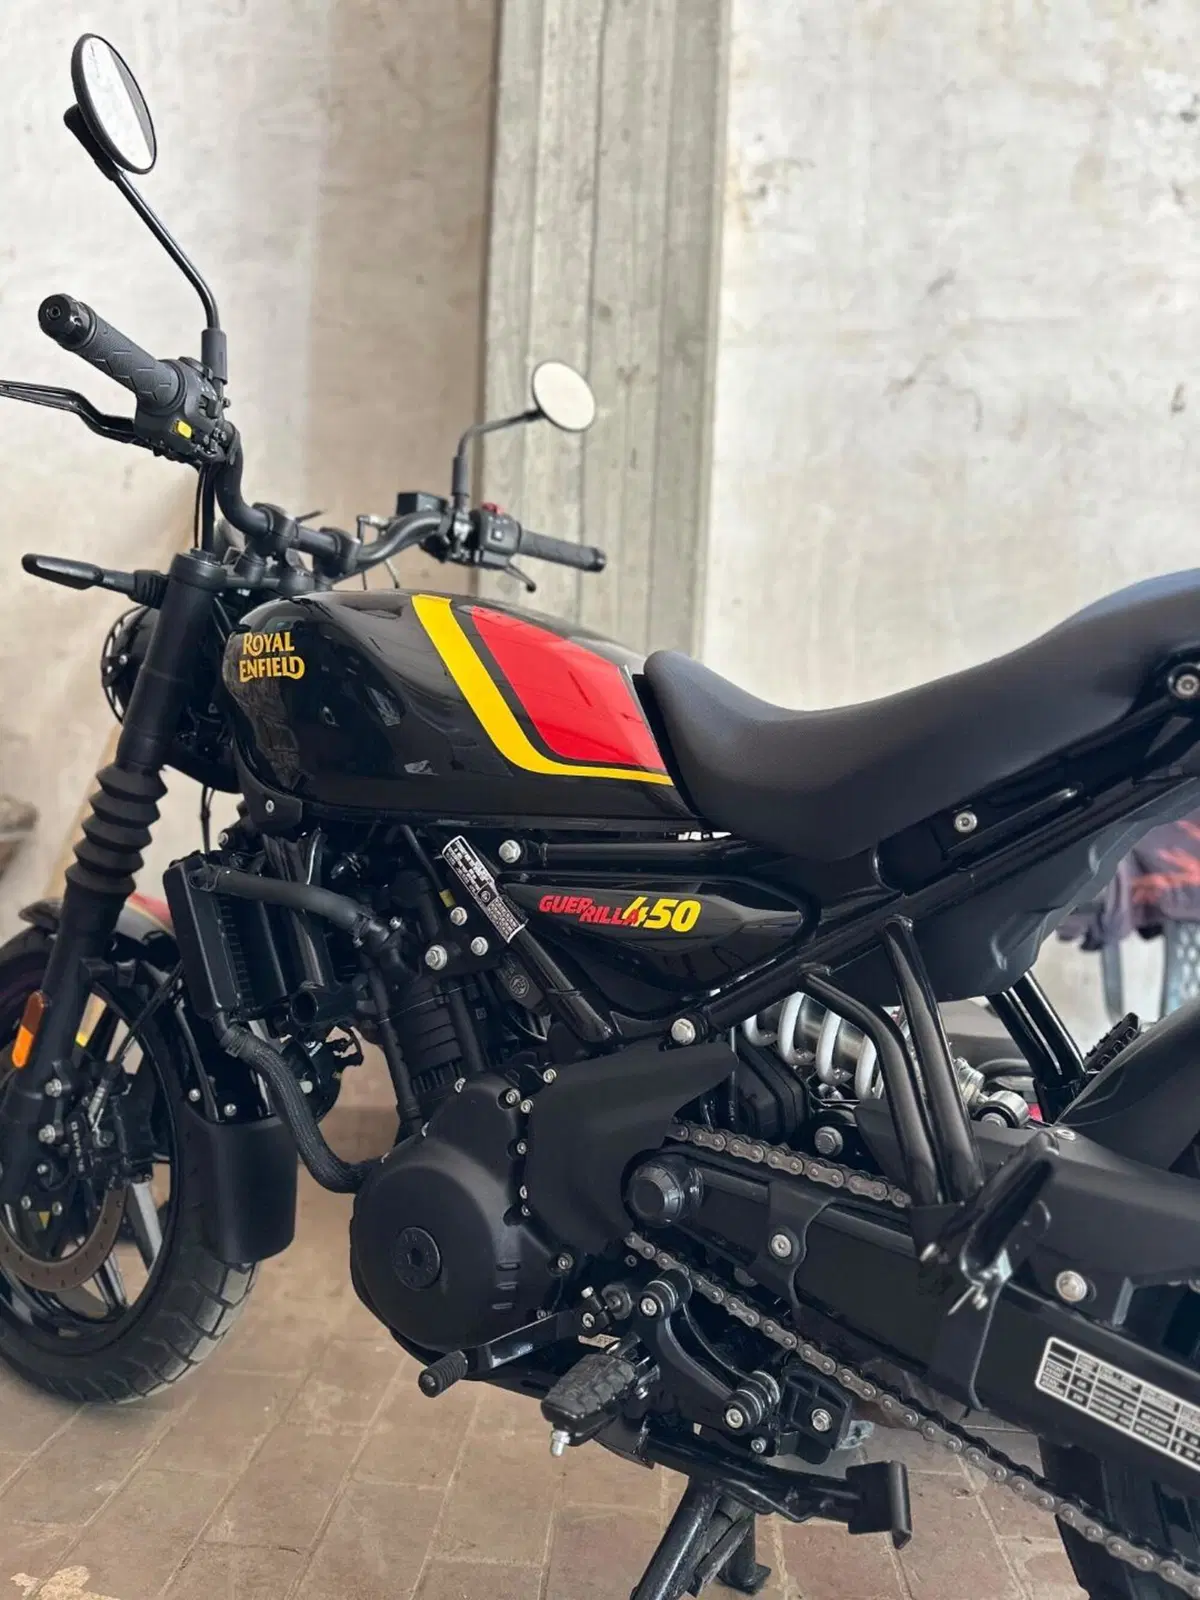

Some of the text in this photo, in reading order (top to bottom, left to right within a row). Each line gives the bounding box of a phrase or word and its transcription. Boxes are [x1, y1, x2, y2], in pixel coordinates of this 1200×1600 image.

[243, 631, 295, 656] ROYAL
[239, 656, 305, 682] ENFIELD
[538, 895, 702, 932] GUERRILLA 450
